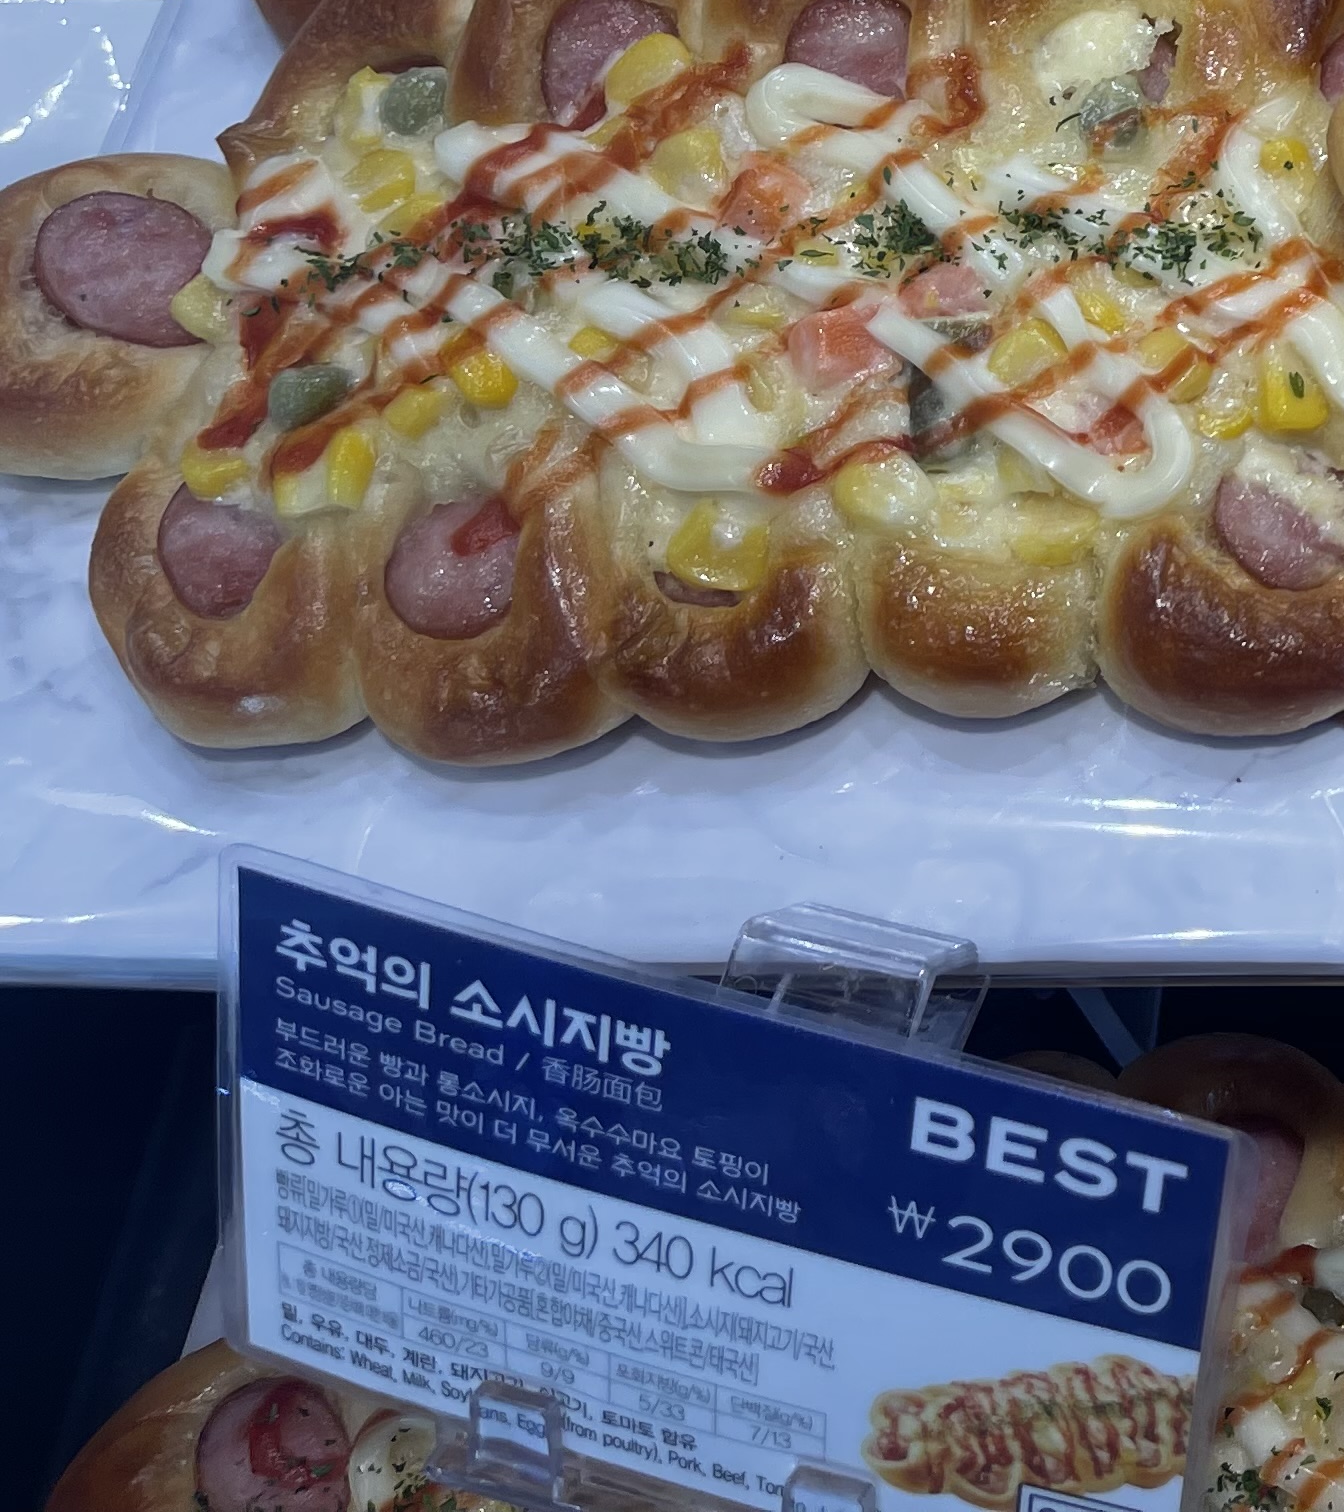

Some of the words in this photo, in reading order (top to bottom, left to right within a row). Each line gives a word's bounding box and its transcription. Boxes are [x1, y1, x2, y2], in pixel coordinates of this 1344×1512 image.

[275, 918, 431, 1011] 추억의
[449, 979, 671, 1077] 소시지빵
[275, 976, 403, 1035] Sausage
[413, 1019, 505, 1067] Bread
[541, 1055, 663, 1113] 香肠面包
[274, 1016, 371, 1069] 부드러운
[379, 1049, 430, 1088] 빵과
[555, 1106, 683, 1162] 옥수수마요
[691, 1144, 770, 1186] 토핑이
[274, 1046, 370, 1099] 조화로운
[378, 1081, 428, 1117] 아는
[435, 1097, 485, 1135] 맛이
[492, 1118, 518, 1146] 더
[525, 1127, 602, 1171] 무서운
[610, 1152, 687, 1195] 추억의
[696, 1179, 802, 1225] 소시지빵
[909, 1095, 1189, 1215] BEST
[275, 1108, 321, 1166] 총
[336, 1131, 545, 1238] 내용량(130
[559, 1204, 600, 1260] g)
[611, 1220, 695, 1281] 340
[709, 1245, 795, 1310] kcal
[418, 1325, 490, 1359] 460/23
[540, 1360, 576, 1385] 9/9
[601, 1409, 654, 1440] 토마토
[750, 1425, 792, 1450] 7/13
